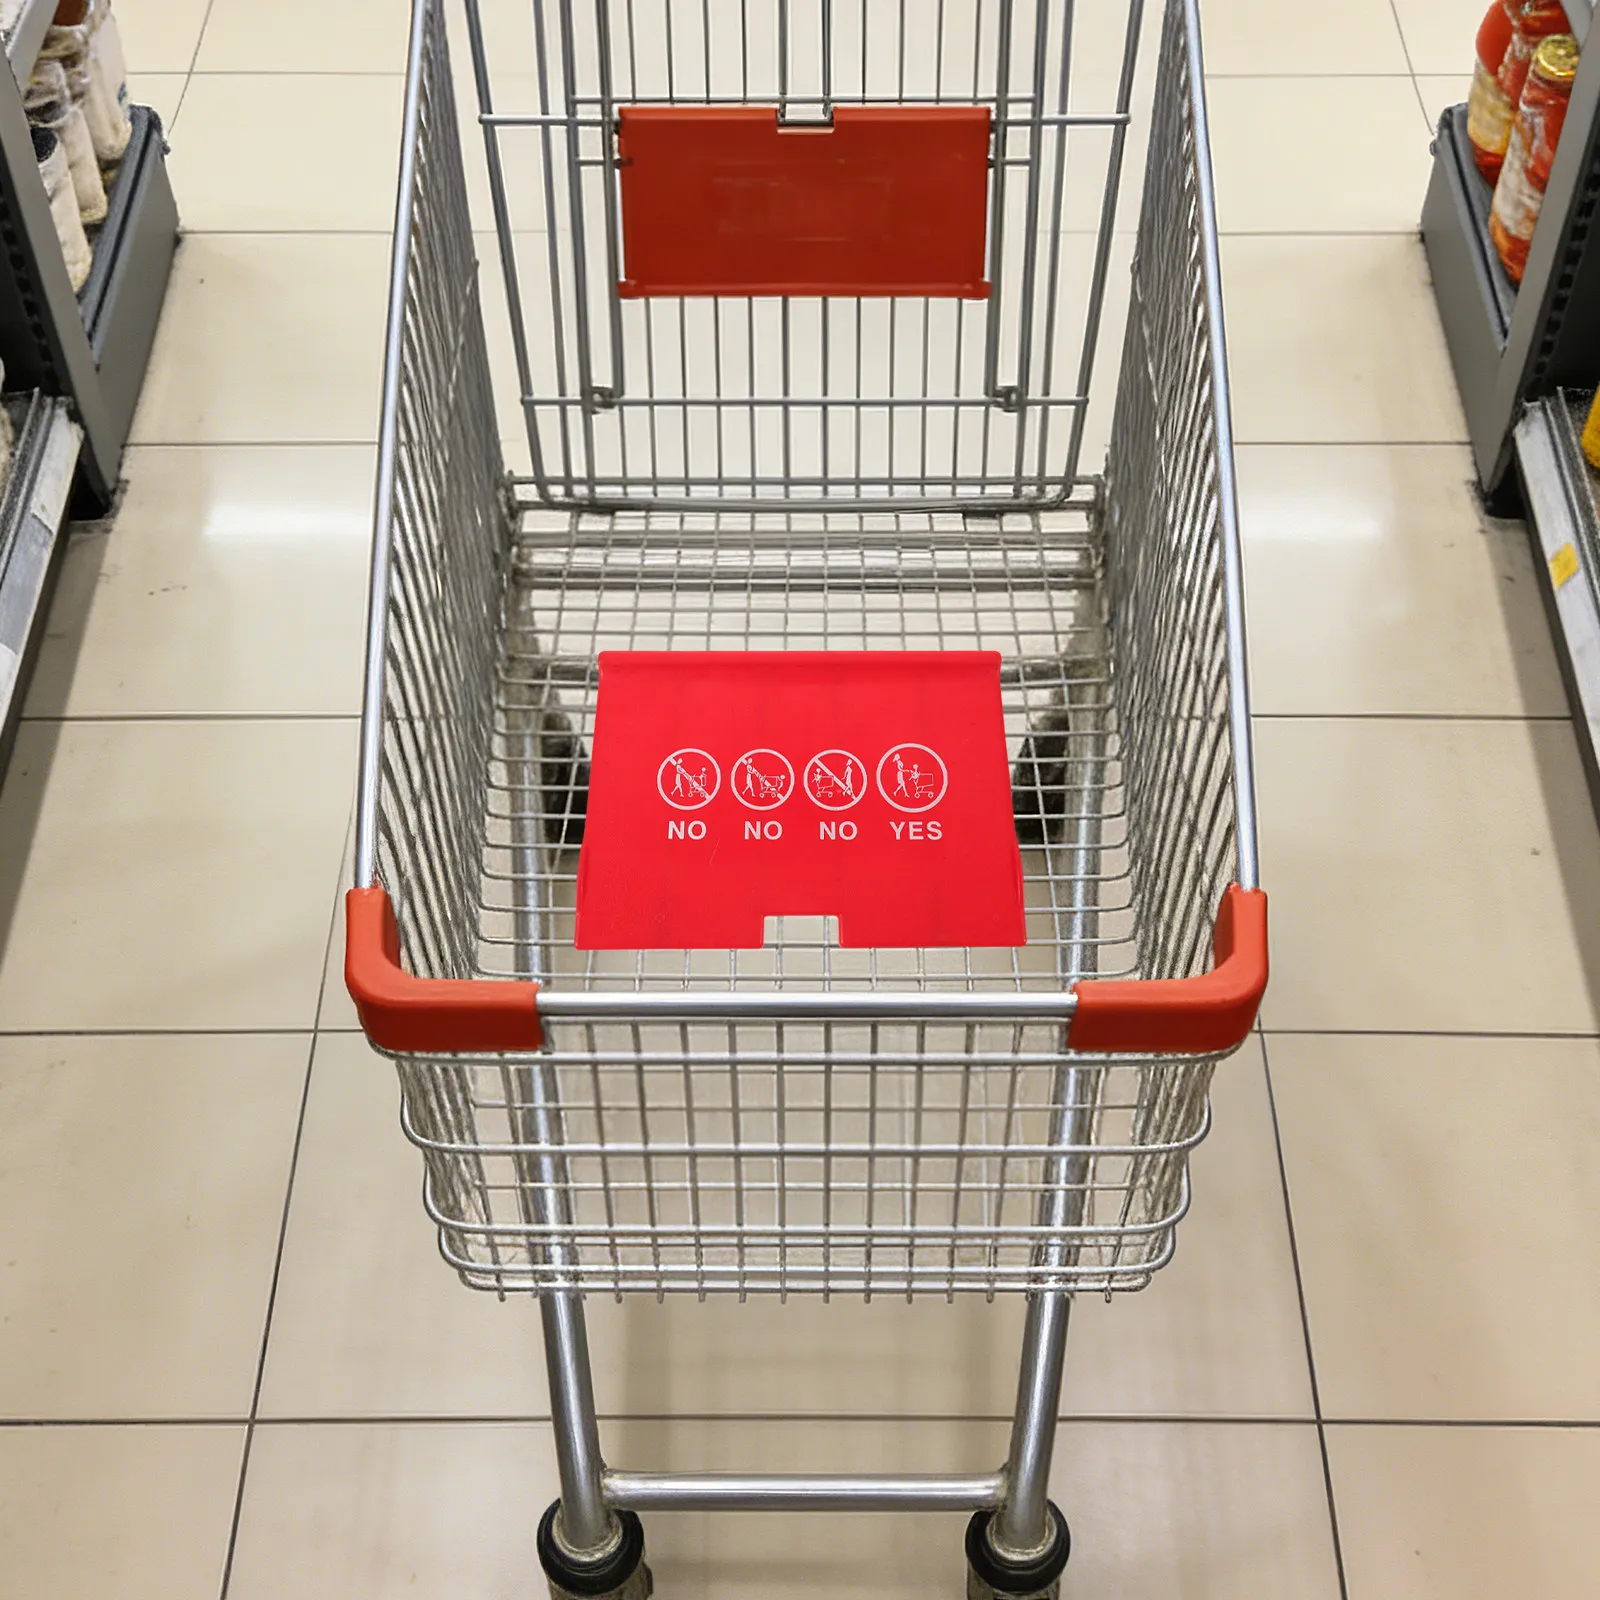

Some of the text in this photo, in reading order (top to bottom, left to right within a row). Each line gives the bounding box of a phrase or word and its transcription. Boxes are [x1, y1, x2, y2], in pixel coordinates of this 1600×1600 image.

[667, 820, 943, 841] NO NO NO YES
